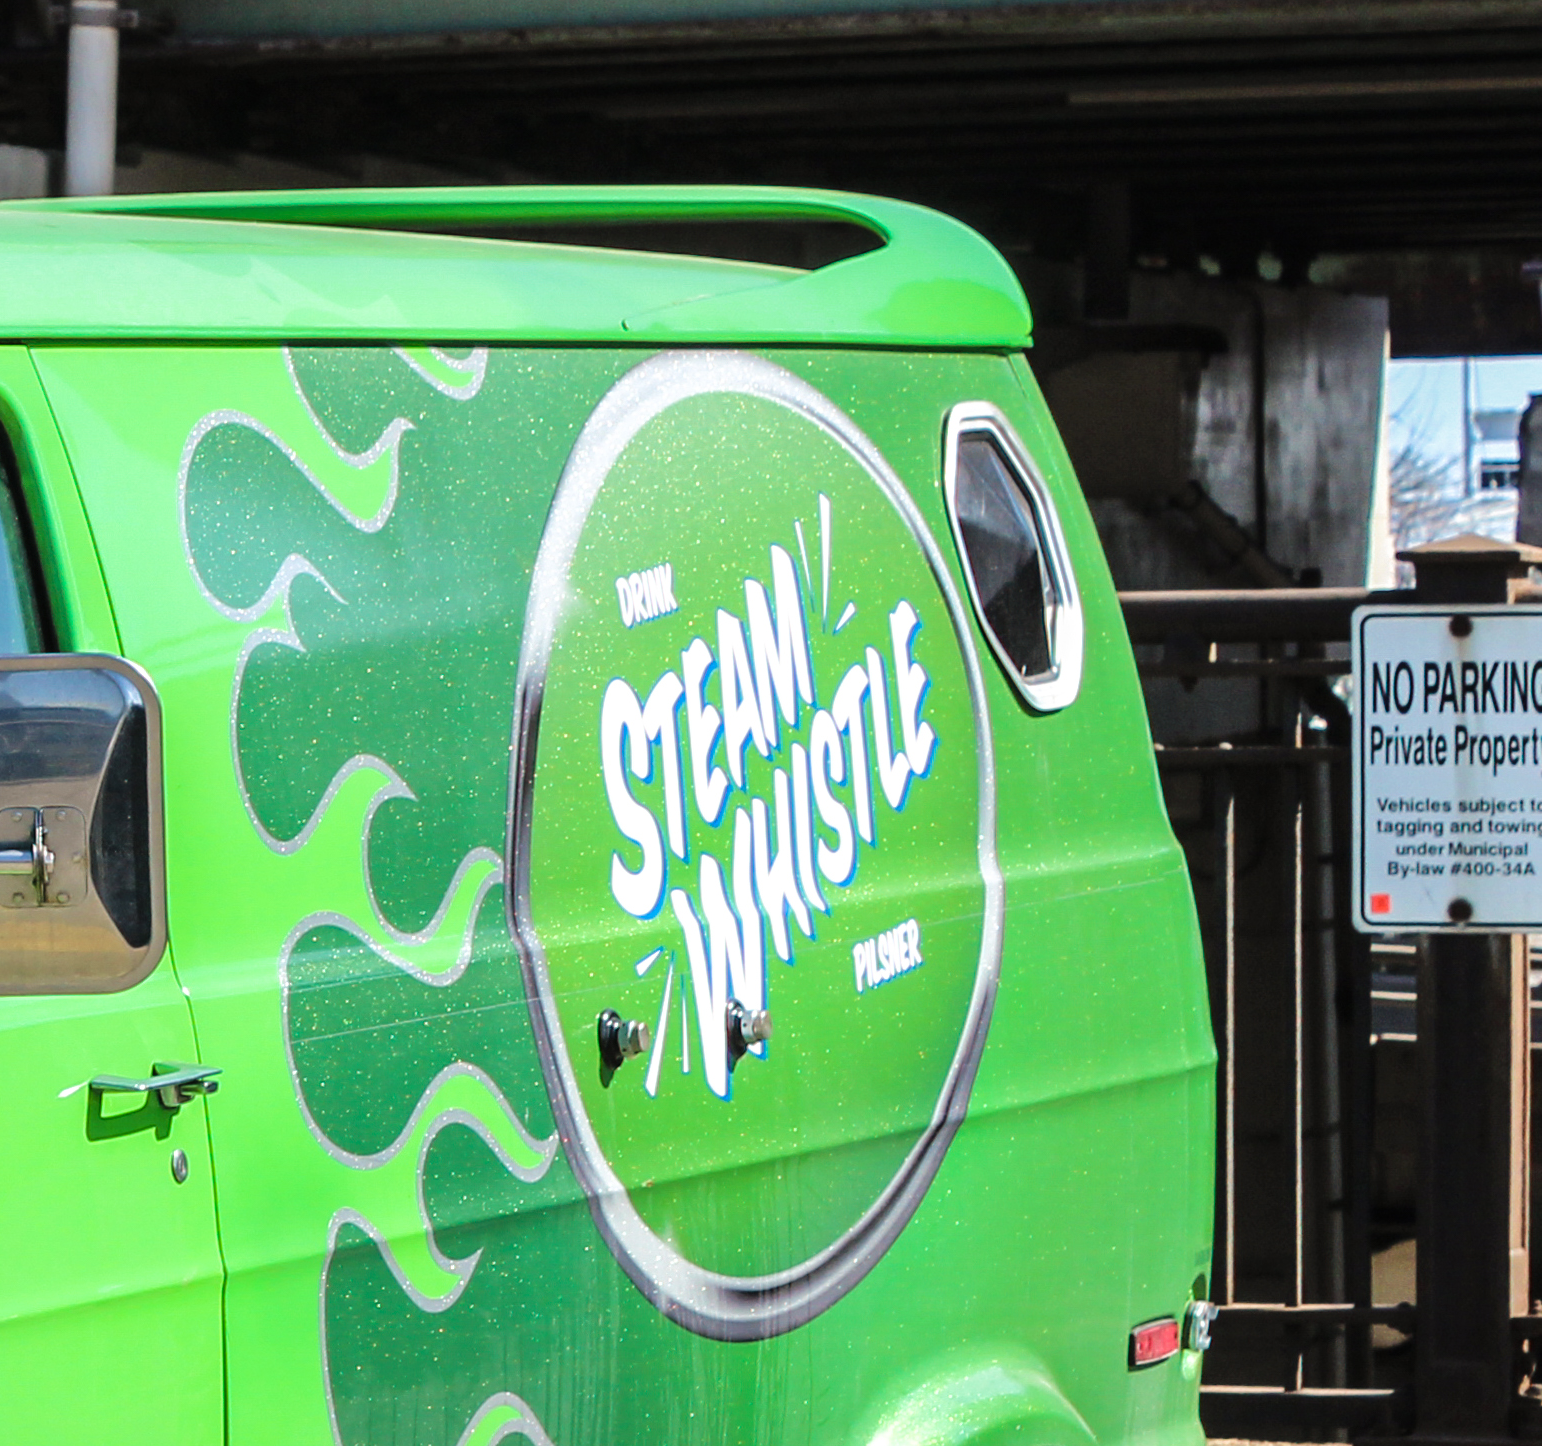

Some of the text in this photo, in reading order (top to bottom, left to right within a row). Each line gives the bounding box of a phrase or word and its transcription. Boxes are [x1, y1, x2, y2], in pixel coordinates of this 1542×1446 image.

[616, 562, 678, 629] DRINK
[1372, 661, 1414, 714] NO
[601, 543, 815, 921] STEAM
[1371, 725, 1542, 777] Private Propert
[1377, 797, 1451, 812] Vehicles
[1459, 797, 1524, 816] subject
[1377, 818, 1443, 837] tagging
[1450, 818, 1482, 833] and
[671, 600, 939, 1101] WHISTLE
[1388, 861, 1536, 879] By-law #400-34A
[1396, 842, 1528, 859] under Municipal
[853, 918, 923, 994] PILSNER
